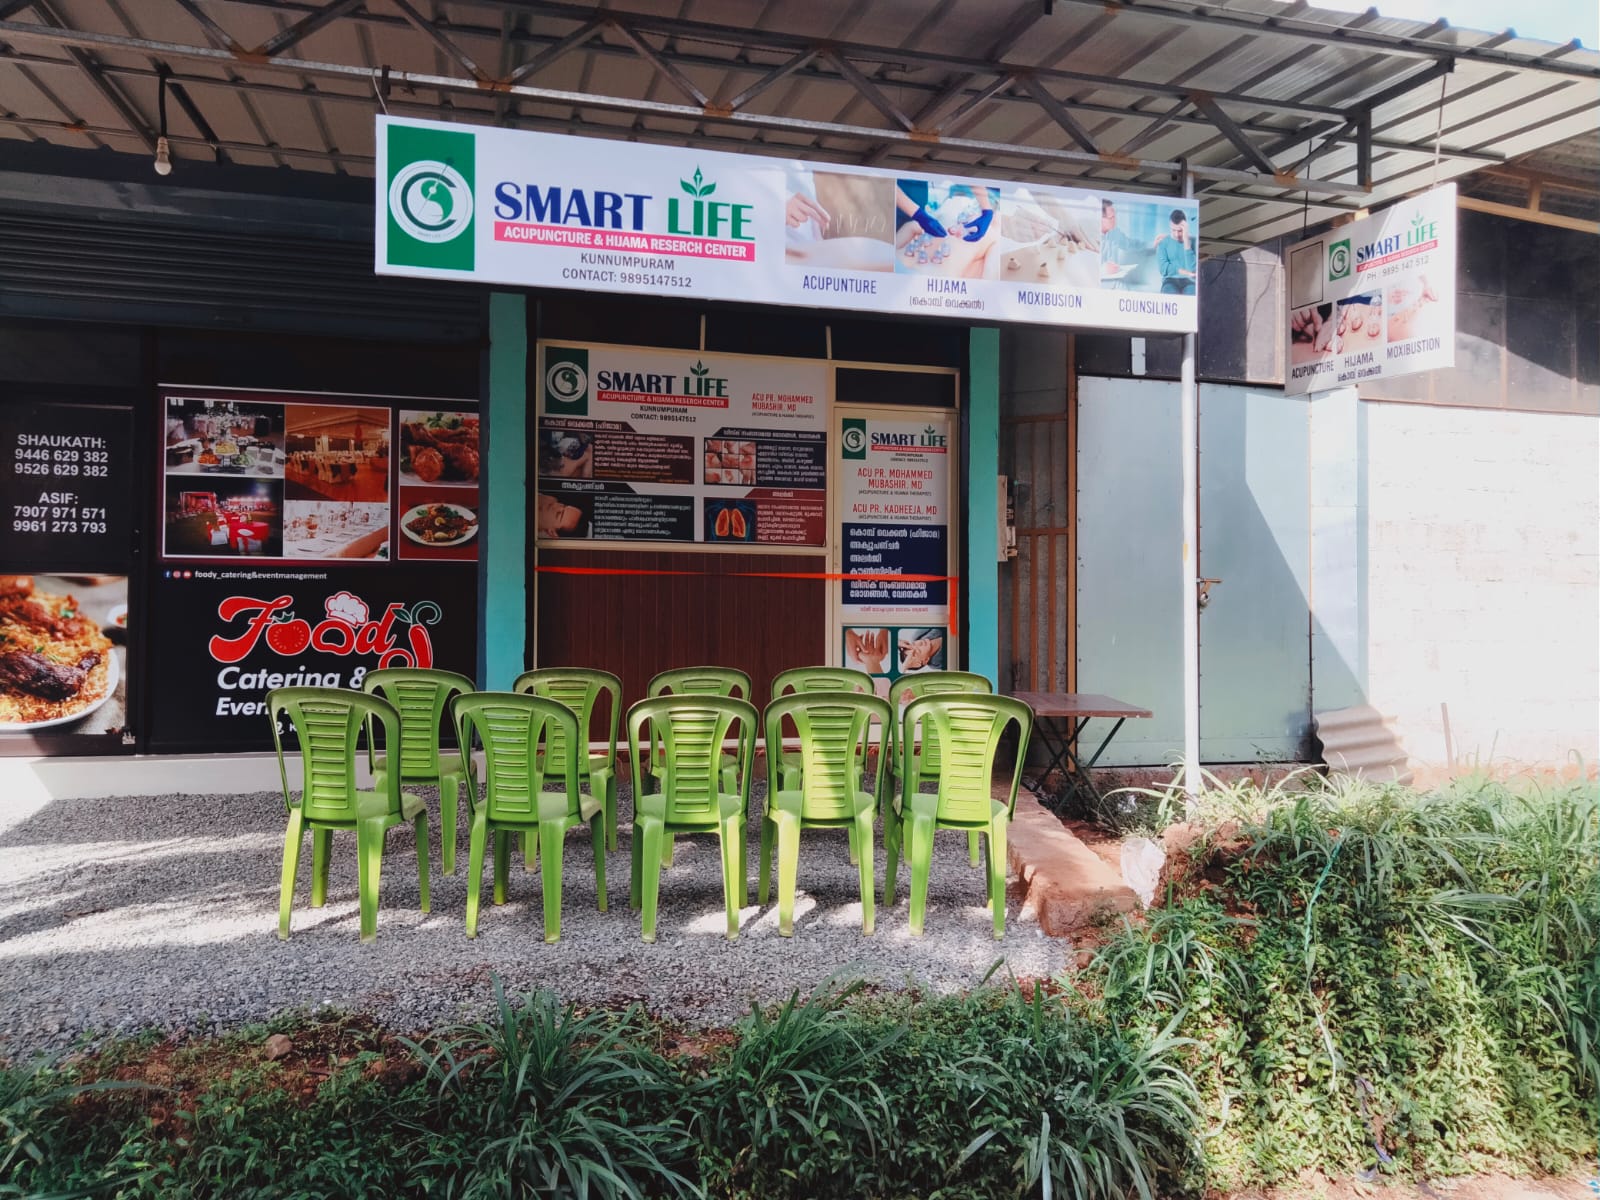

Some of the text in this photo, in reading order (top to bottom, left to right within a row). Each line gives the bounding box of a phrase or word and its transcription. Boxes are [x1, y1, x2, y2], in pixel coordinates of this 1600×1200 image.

[494, 181, 755, 241] SMART LIFE
[503, 226, 747, 258] ACUPUNCTURE & HIJAMA RESERCH CENTER
[1356, 233, 1402, 264] SMART
[1407, 222, 1438, 247] LIFE
[580, 252, 675, 271] KUNNUMPURAM
[562, 267, 692, 288] CONTACT: 9895147512
[802, 274, 877, 294] ACUPUNTURE
[927, 278, 967, 295] HIJAMA
[1017, 290, 1083, 309] MOXIBUSION
[1119, 298, 1178, 316] COUNSILING
[1386, 337, 1440, 359] MOXIBUSTION
[1344, 351, 1374, 368] HIJAMA
[1291, 360, 1335, 380] ACUPUNCTURE
[597, 370, 729, 398] SMART LIFE
[601, 392, 645, 402] ACUPUNCTURE
[703, 399, 725, 407] CENTER
[16, 433, 107, 449] SHAUKATH:
[870, 432, 947, 448] SMART LIFE
[15, 448, 108, 463] 9446 629 382
[15, 462, 108, 477] 9526 629 382
[857, 467, 933, 480] ACU PR. MOHAMMED
[911, 480, 923, 490] MD
[38, 491, 79, 505] ASIF:
[13, 505, 106, 520] 7907 971 571
[853, 503, 868, 513] ACU
[870, 504, 882, 514] PR.
[926, 505, 937, 515] MD
[13, 519, 107, 534] 9961 273 793
[216, 665, 341, 690] Catering
